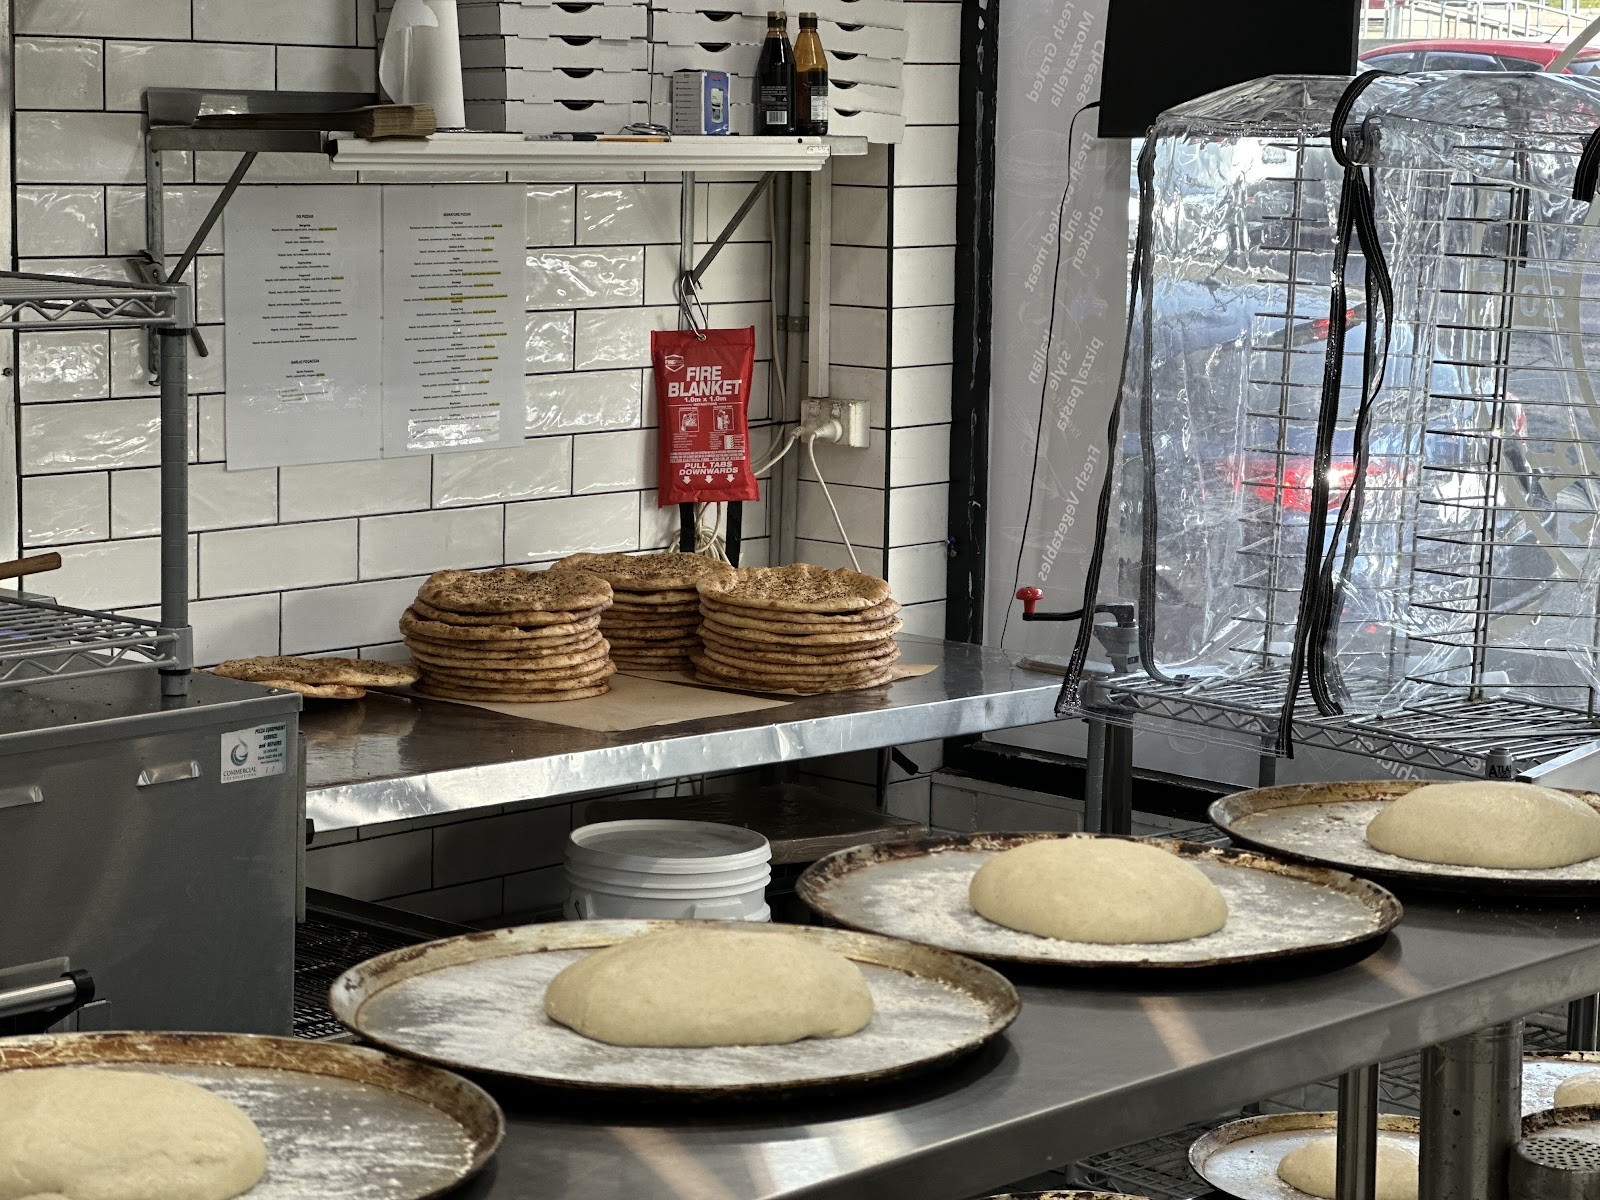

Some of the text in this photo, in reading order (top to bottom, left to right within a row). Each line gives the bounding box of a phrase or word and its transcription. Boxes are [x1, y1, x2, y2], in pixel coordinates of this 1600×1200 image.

[686, 365, 722, 381] FIRE
[668, 379, 742, 397] BLANKET
[679, 467, 739, 476] DOWNWARDS
[223, 767, 256, 776] COMMERCIAL
